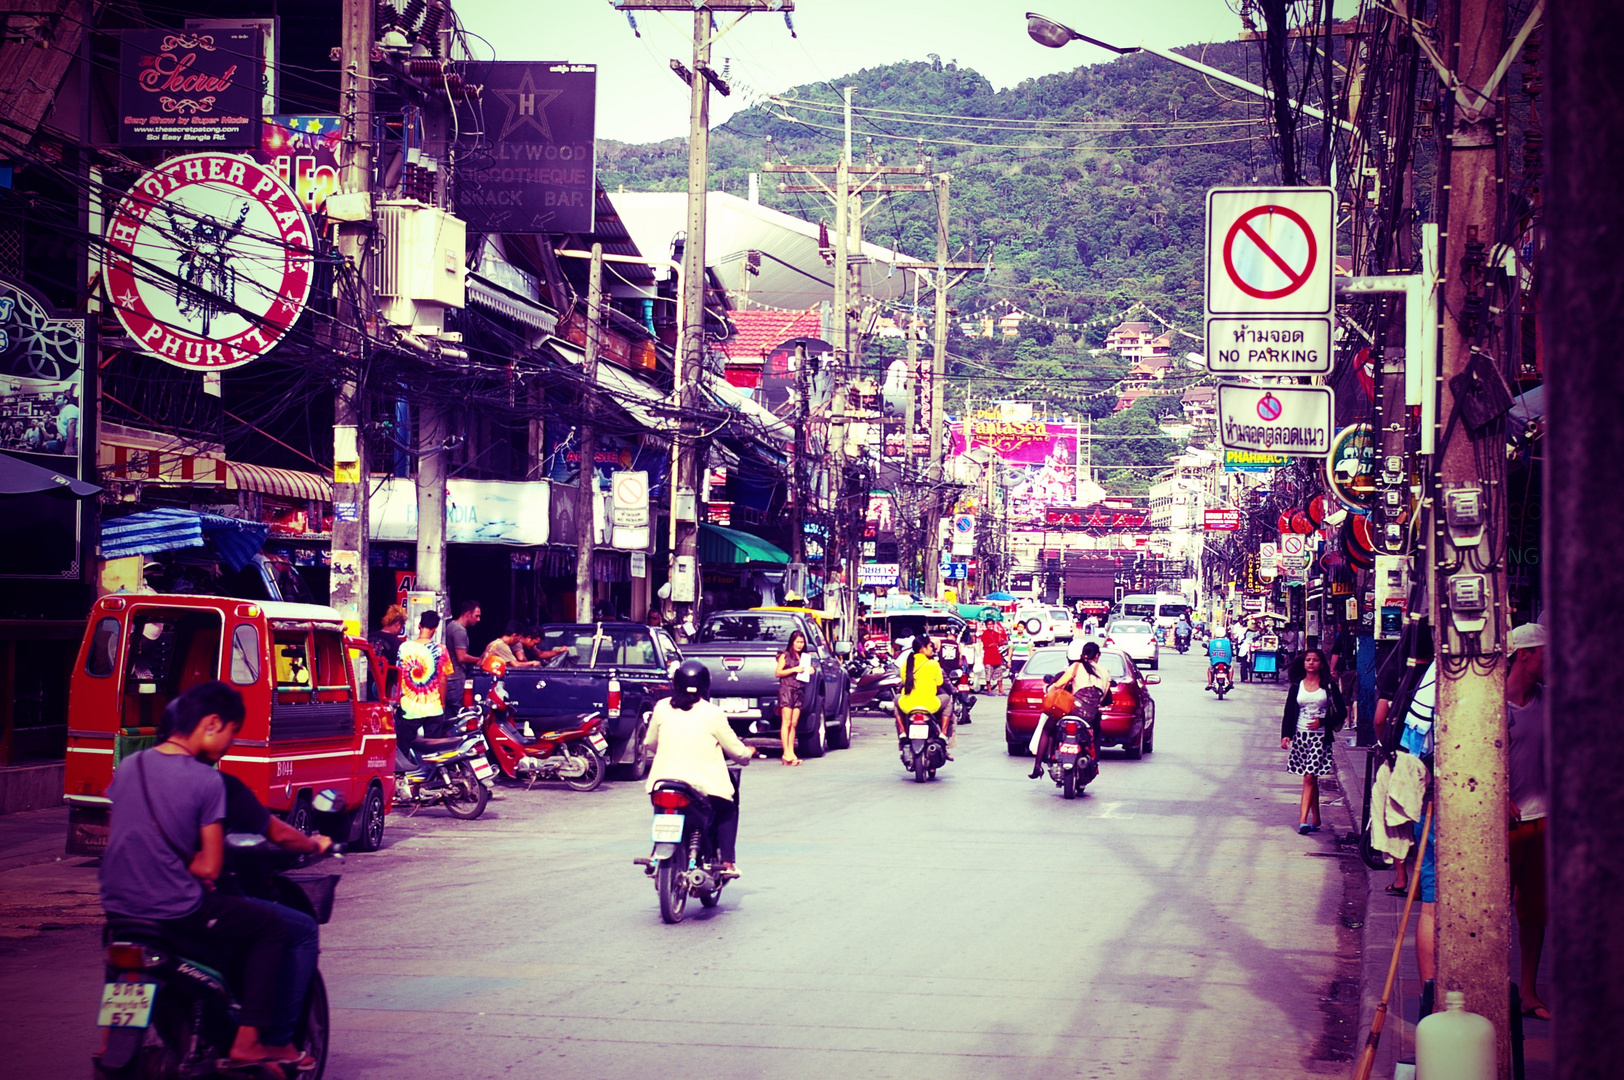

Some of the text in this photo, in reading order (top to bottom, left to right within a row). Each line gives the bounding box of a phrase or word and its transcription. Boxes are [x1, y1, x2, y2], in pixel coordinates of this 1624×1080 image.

[139, 52, 238, 93] Secret
[519, 93, 535, 116] H
[124, 116, 147, 126] Sexy
[149, 116, 176, 125] Show
[177, 116, 190, 126] by
[191, 116, 220, 126] Super
[133, 126, 240, 134] www.thesecretpatong.com
[161, 134, 182, 142] Easy
[183, 134, 211, 142] Bangla
[144, 158, 247, 200] OTHER
[461, 190, 584, 207] SNACK BAR
[1232, 324, 1305, 343] ห้ามจอด
[143, 323, 270, 365] PHUKET
[1219, 350, 1319, 363] NO PARKING
[1224, 415, 1325, 447] ห้ามจอดตลอดแนว
